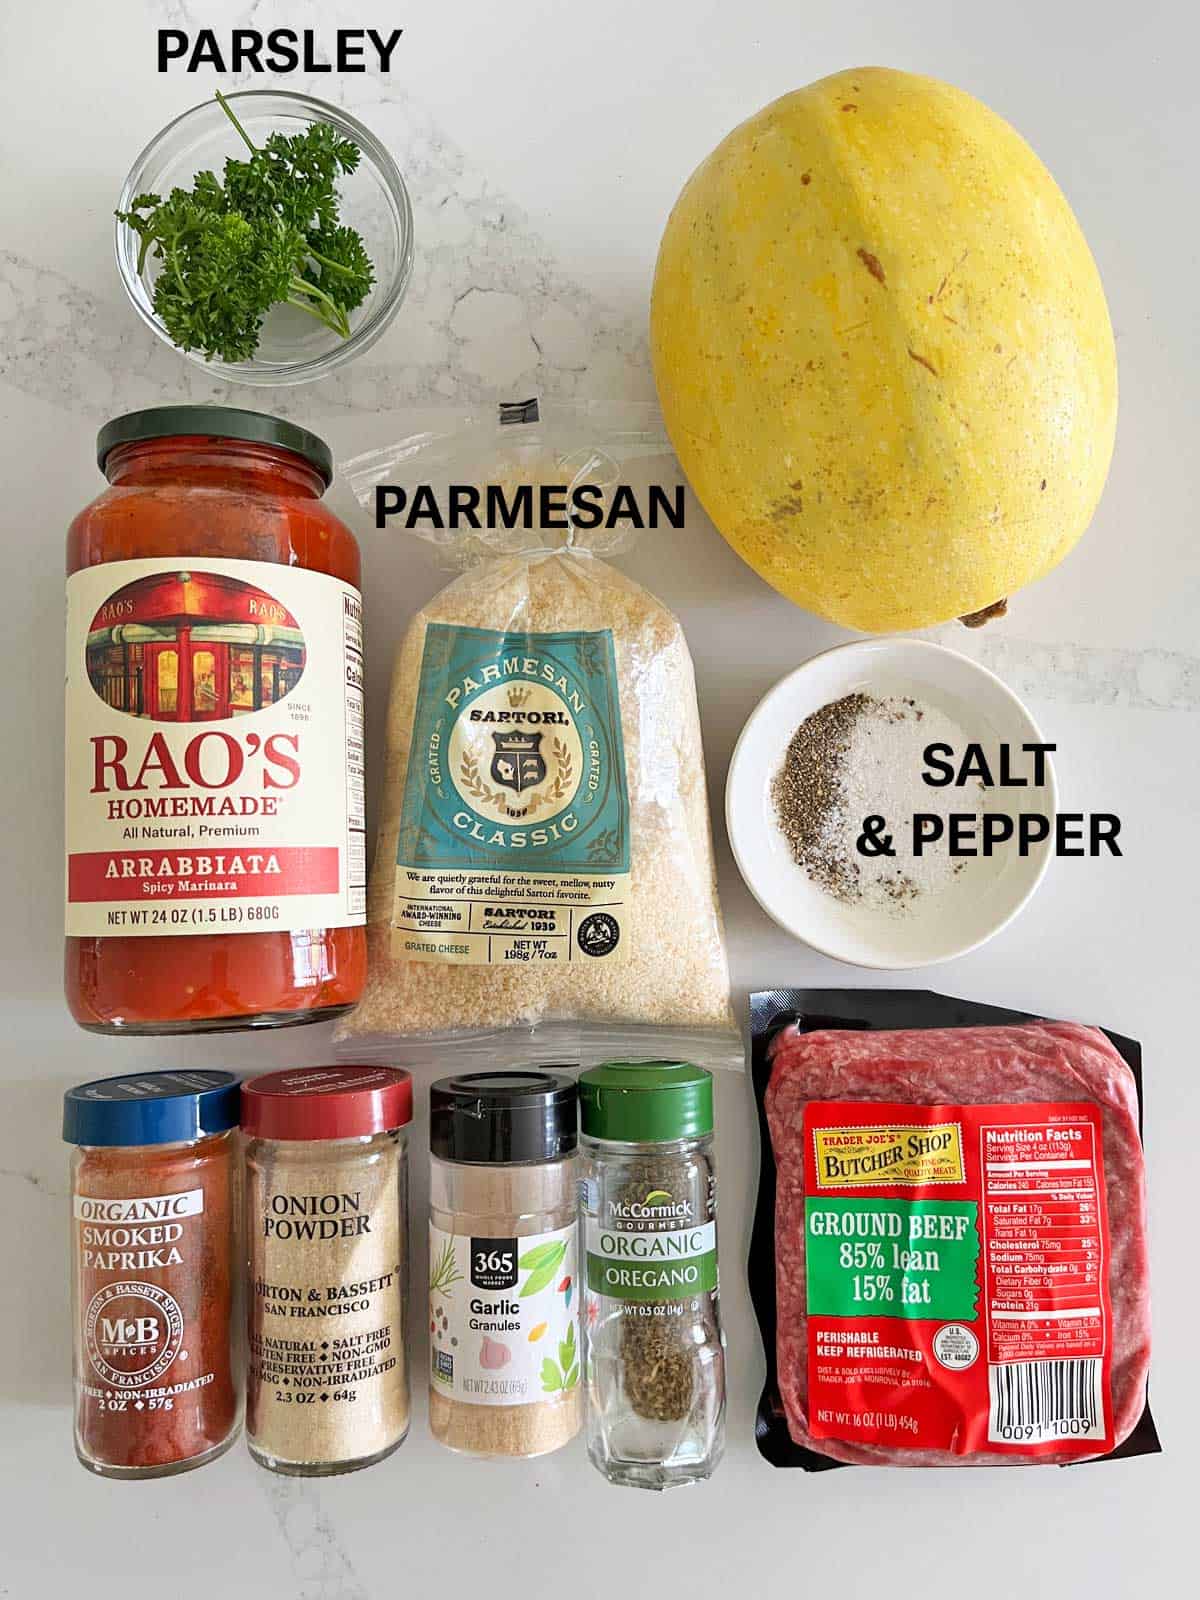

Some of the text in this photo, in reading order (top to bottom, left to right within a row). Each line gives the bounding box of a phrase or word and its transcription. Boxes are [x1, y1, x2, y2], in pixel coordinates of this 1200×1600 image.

[101, 600, 135, 621] RAO'S
[248, 600, 287, 621] RAO'S
[445, 656, 586, 715] PARMESAN
[89, 730, 302, 793] RAO'S
[429, 732, 441, 784] GRATED
[588, 739, 599, 791] GRATED
[107, 795, 279, 821] HOMEMADE
[122, 824, 260, 840] All Natural, Premium
[453, 813, 578, 848] CLASSIC
[105, 854, 283, 880] ARRABBIATA
[143, 879, 238, 894] Spicy Marinara
[406, 872, 422, 882] We
[422, 874, 436, 883] are
[437, 873, 467, 885] quietly
[468, 874, 502, 886] grateful
[502, 875, 516, 885] for
[516, 876, 531, 885] the
[532, 877, 559, 888] sweet,
[592, 879, 616, 890] nutty
[429, 884, 592, 900] flavor of this delightful Sartori favorite.
[108, 906, 280, 925] NET WT 24 OZ (1.5 LB) 680G
[401, 909, 462, 921] AWARD-WINNING
[484, 907, 556, 919] SARTORI
[531, 921, 556, 931] 1939
[404, 941, 470, 954] GRATED CHEESE
[513, 940, 548, 949] NET WT
[504, 950, 529, 961] 198g
[539, 950, 558, 960] 7oz
[822, 1134, 897, 1146] TRADER JOE'S
[986, 1128, 1082, 1143] Nutrition Facts
[824, 1132, 952, 1178] BUTCHER SHOP
[986, 1143, 1015, 1153] Serving
[933, 1166, 957, 1176] MEATS
[987, 1181, 1018, 1190] Calories
[81, 1196, 188, 1222] ORGANIC
[272, 1192, 361, 1216] ONION
[608, 1200, 694, 1218] McCormick
[989, 1204, 1011, 1214] Total
[1013, 1203, 1027, 1213] Fat
[264, 1215, 372, 1241] POWDER
[616, 1219, 686, 1231] GOURMET
[810, 1212, 970, 1240] GROUND BEEF
[993, 1215, 1028, 1226] Saturated
[1029, 1215, 1041, 1225] Fat
[82, 1223, 184, 1247] SMOKED
[600, 1231, 703, 1258] ORGANIC
[990, 1240, 1062, 1251] Cholesterol 75mg
[82, 1247, 184, 1270] PAPRIKA
[475, 1249, 512, 1273] 365
[839, 1243, 939, 1272] 85% lean
[990, 1252, 1023, 1262] Sodium
[606, 1265, 698, 1287] OREGANO
[991, 1264, 1067, 1275] Total Carbohydrate
[307, 1288, 321, 1302] &
[327, 1272, 393, 1301] BASSETT
[852, 1274, 931, 1304] 15% fat
[115, 1283, 164, 1302] BASSETT
[161, 1296, 182, 1336] SPICES
[264, 1299, 370, 1318] SAN FRANCISCO
[469, 1299, 520, 1316] Garlic
[624, 1304, 637, 1315] WT
[639, 1304, 652, 1316] 0.5
[653, 1305, 665, 1316] OZ
[991, 1300, 1024, 1310] Protein
[469, 1318, 521, 1332] Granules
[265, 1325, 391, 1352] NATURAL SALT FREE
[816, 1331, 880, 1344] PERISHABLE
[103, 1345, 157, 1357] SPICES
[287, 1337, 391, 1364] FREE NON-GMO
[816, 1345, 922, 1361] KEEP REFRIGERATED
[111, 1349, 174, 1386] FRANCISCO
[261, 1360, 344, 1376] PRESERVATIVE
[347, 1355, 376, 1371] FREE
[293, 1357, 397, 1387] NON-IRRADIATED
[115, 1373, 214, 1400] NON-IRRADIATED
[98, 1397, 174, 1411] 2 OZ 57g
[275, 1389, 357, 1404] 2.3 OZ 64g
[817, 1409, 833, 1423] NET
[836, 1411, 851, 1424] WT.
[852, 1413, 861, 1426] 16
[862, 1414, 875, 1427] OZ
[883, 1414, 897, 1428] LB)
[898, 1417, 919, 1434] 454g
[1002, 1419, 1091, 1440] 0091 1009
